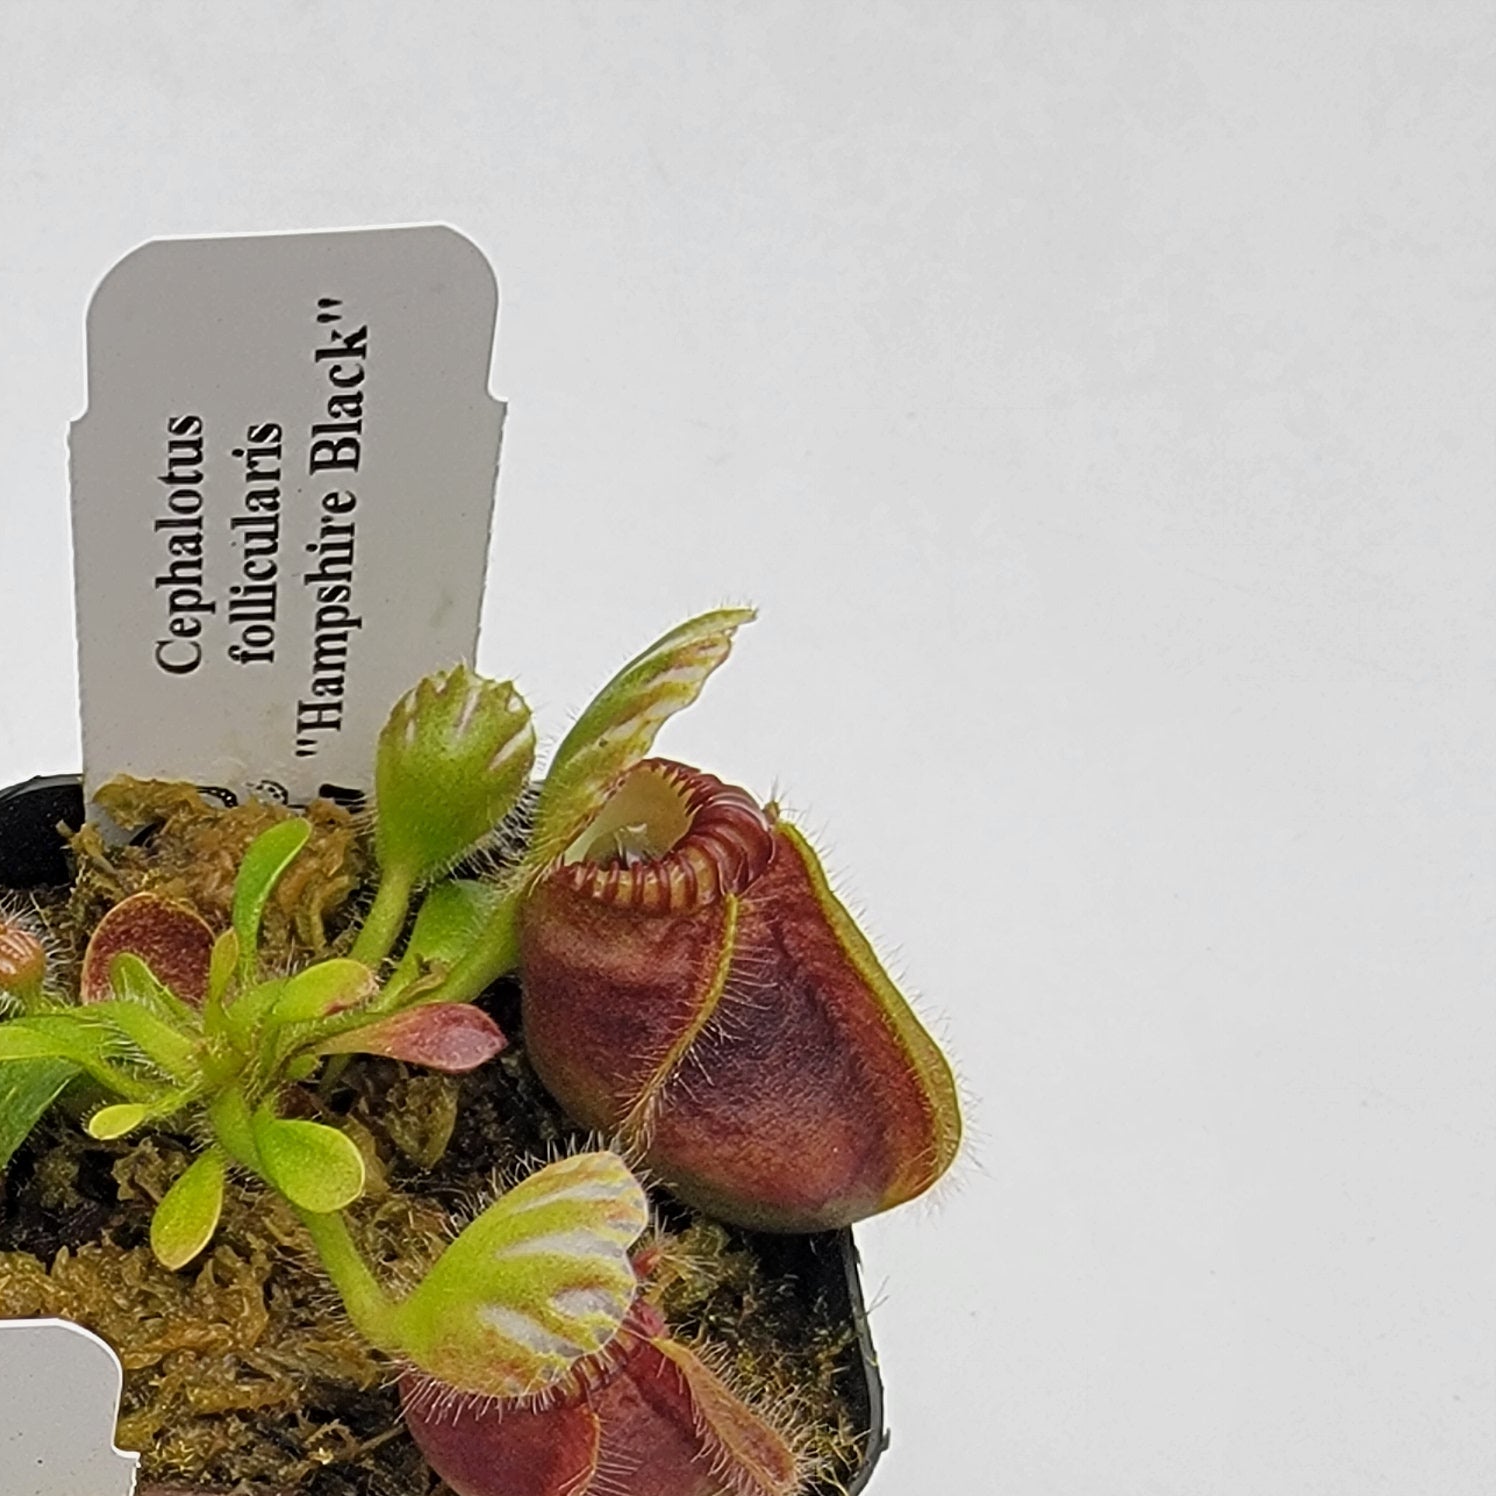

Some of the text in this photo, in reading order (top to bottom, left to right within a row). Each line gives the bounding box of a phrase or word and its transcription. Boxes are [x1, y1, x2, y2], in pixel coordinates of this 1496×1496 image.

[154, 415, 217, 675] Cephalotus
[227, 423, 283, 665] follicularis
[295, 298, 368, 757] "Hampshire Black"
